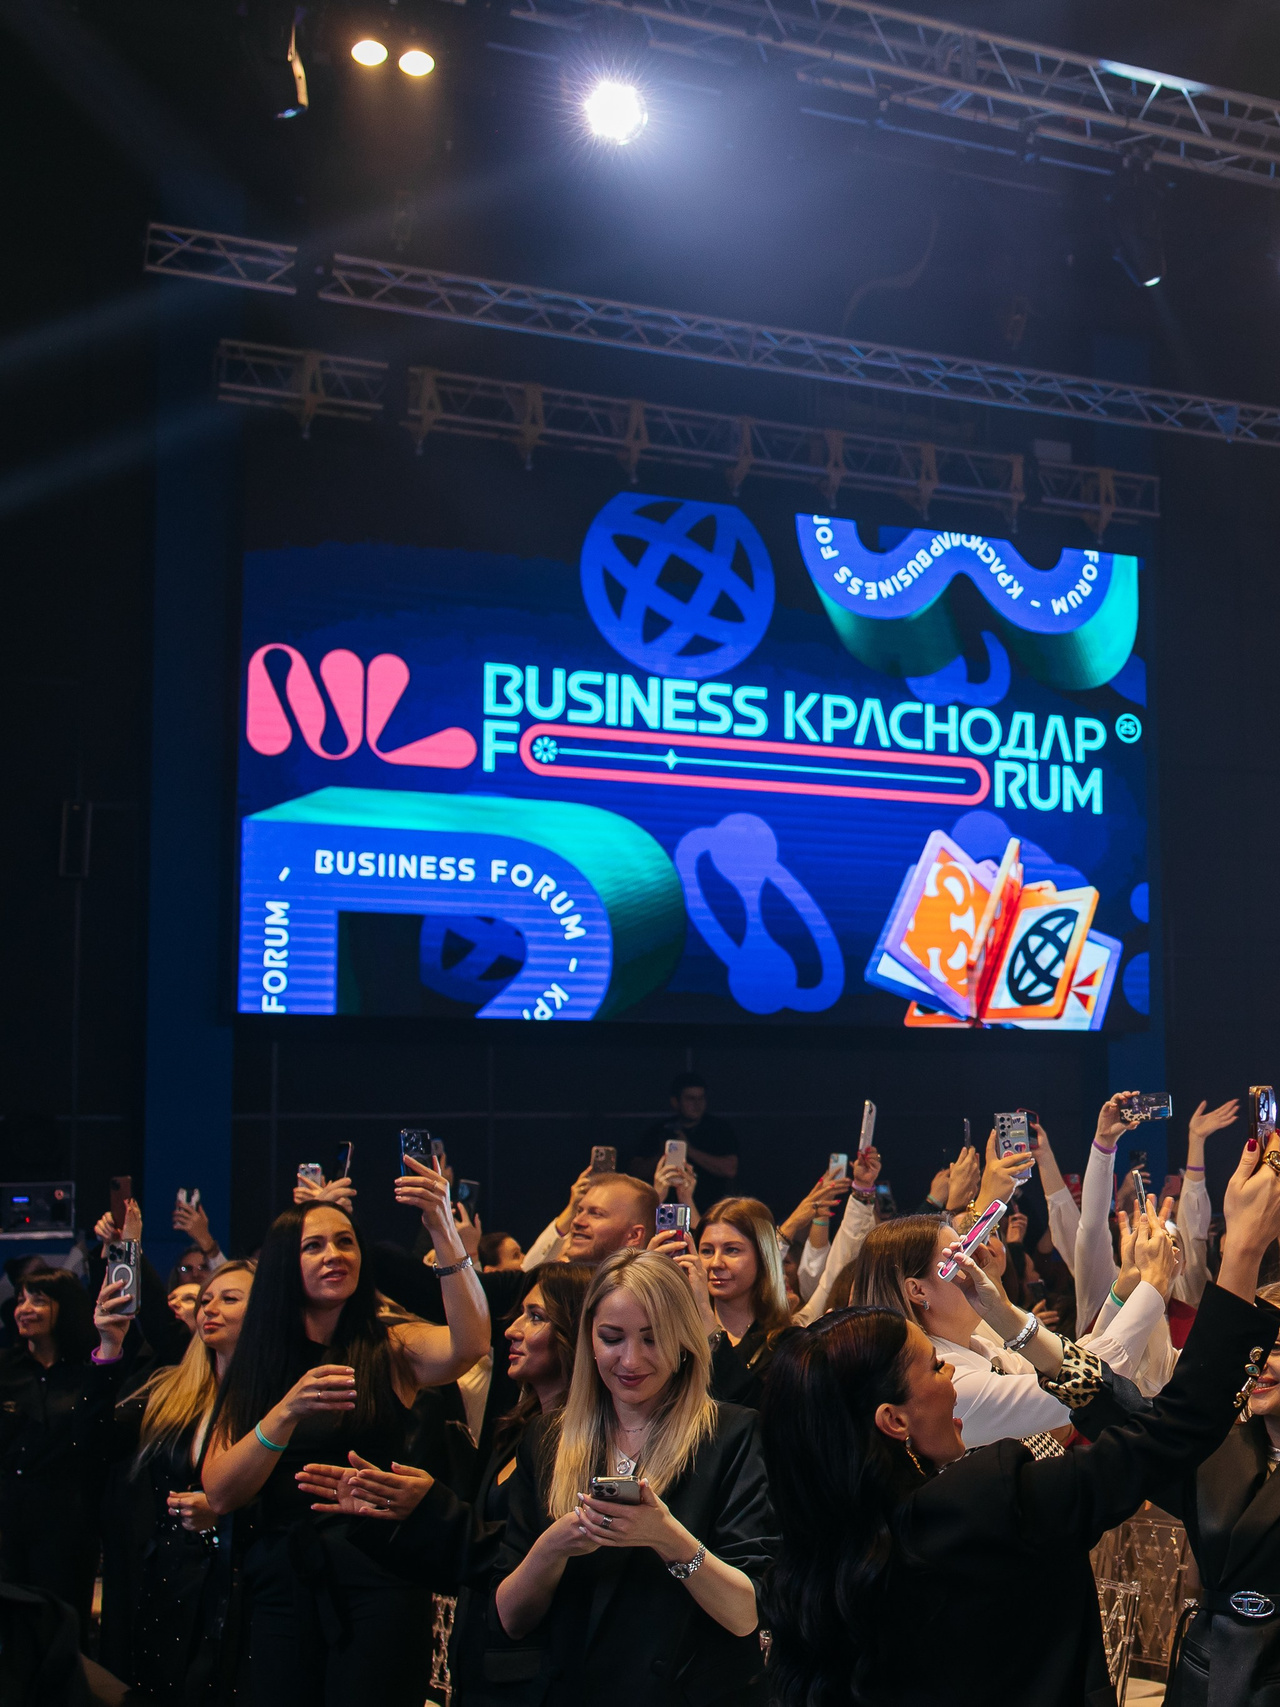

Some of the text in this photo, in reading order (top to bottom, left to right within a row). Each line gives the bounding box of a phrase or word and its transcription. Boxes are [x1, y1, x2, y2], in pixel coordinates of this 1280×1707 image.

[833, 549, 934, 601] BUSINESS
[1050, 550, 1099, 616] FORUM
[483, 661, 769, 738] BUSINESS
[783, 690, 1107, 764] КРАСНОДАР
[314, 849, 475, 882] BUSIINESS
[490, 859, 586, 940] FORUM
[261, 901, 290, 1013] FORUM
[522, 983, 569, 1020] КР
